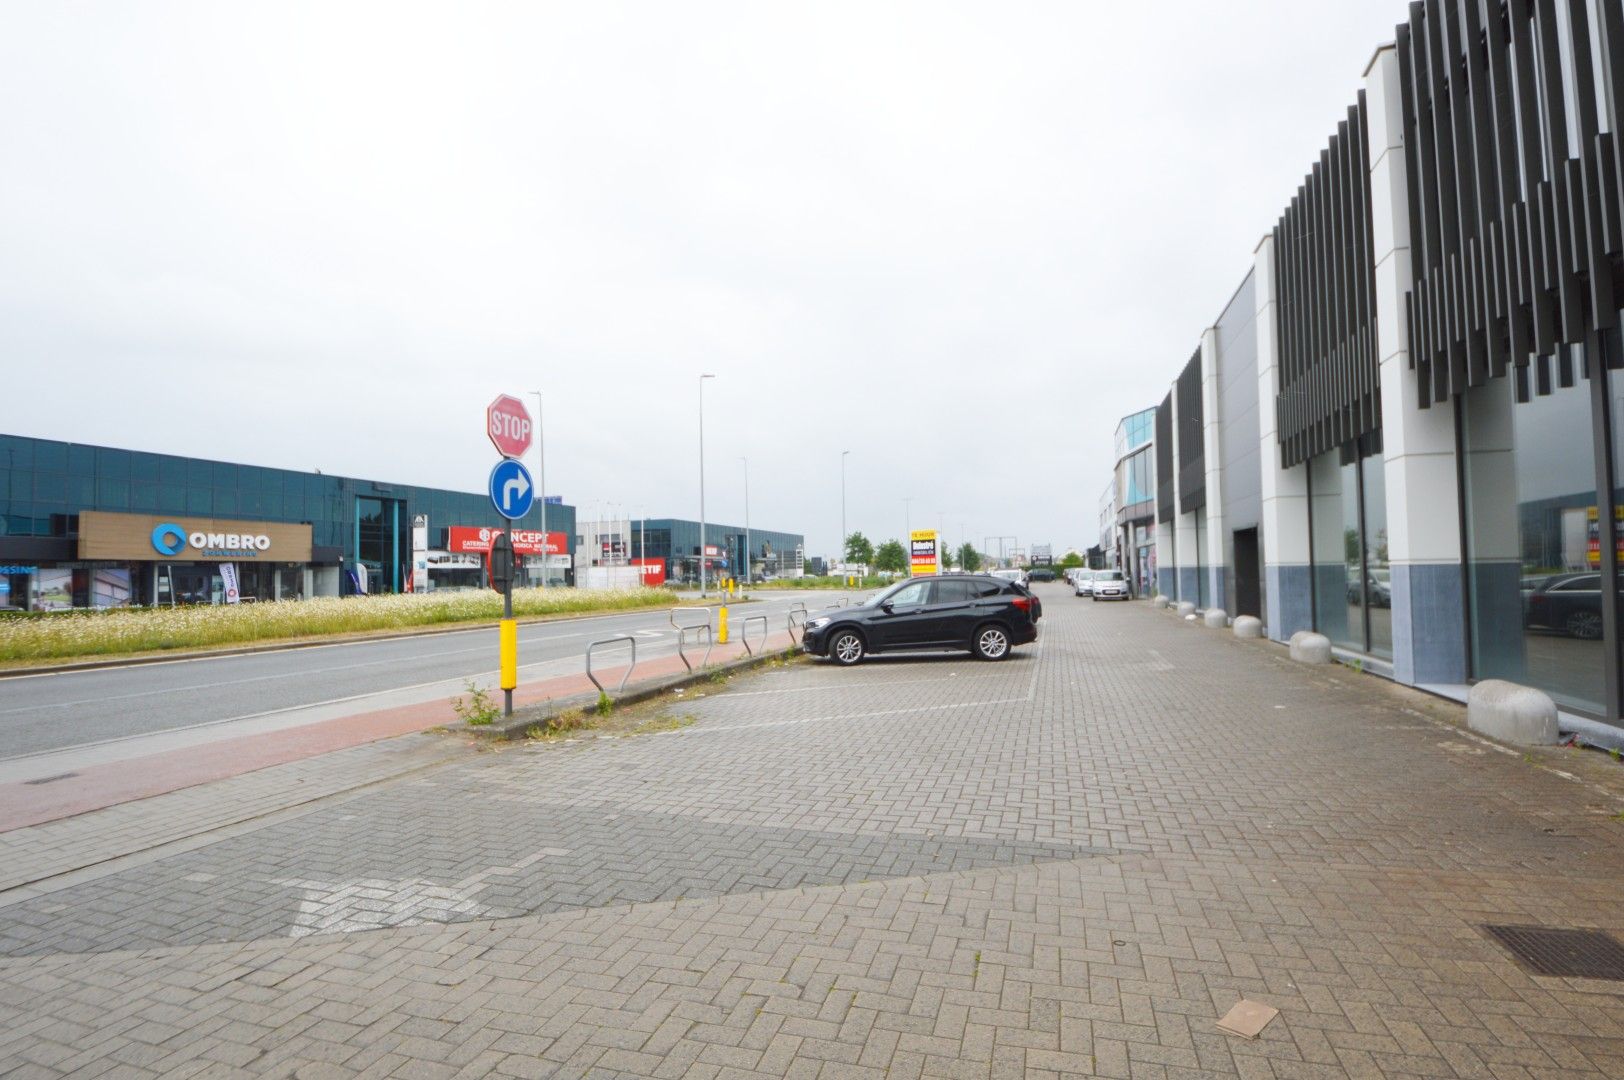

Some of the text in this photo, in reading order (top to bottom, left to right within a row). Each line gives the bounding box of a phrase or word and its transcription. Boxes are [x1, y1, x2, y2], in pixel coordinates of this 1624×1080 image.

[492, 410, 530, 443] STOP
[189, 532, 271, 550] OMBRO
[491, 530, 549, 543] CNCEPT
[634, 564, 662, 575] ETIF
